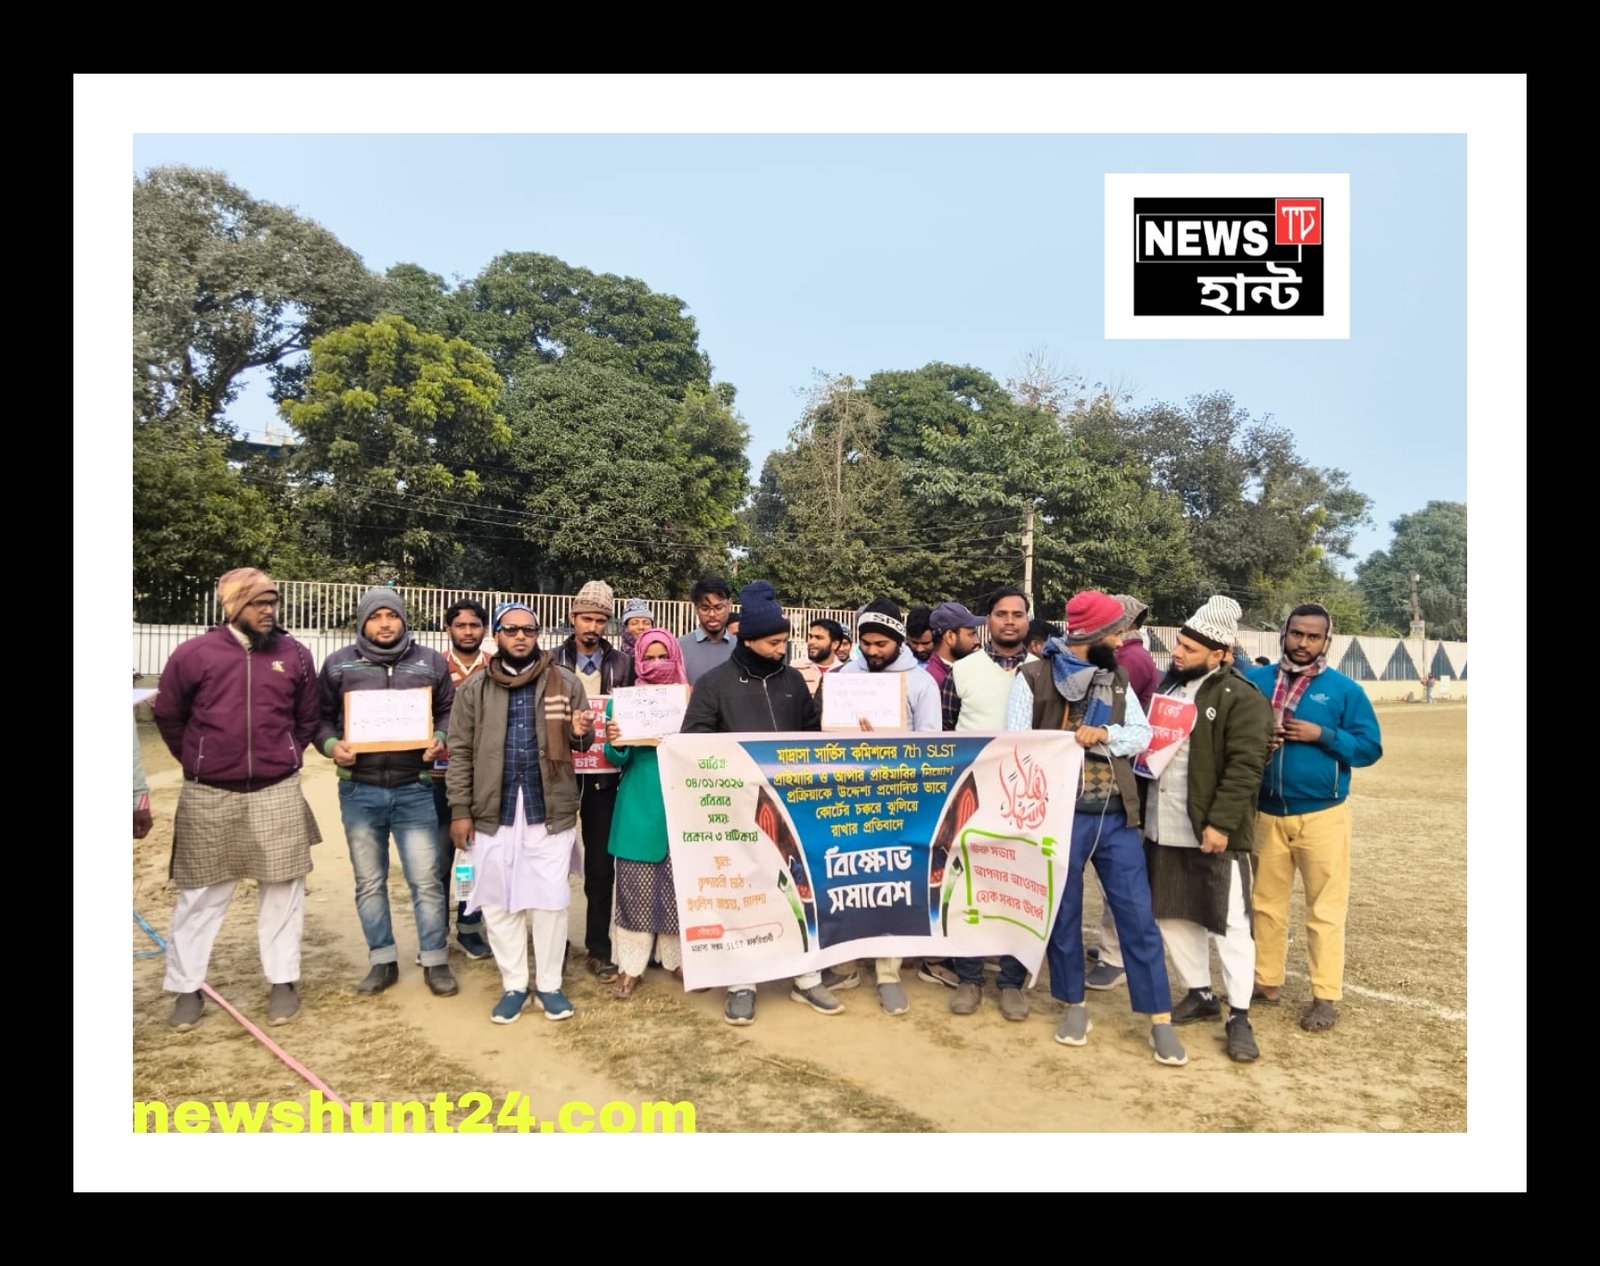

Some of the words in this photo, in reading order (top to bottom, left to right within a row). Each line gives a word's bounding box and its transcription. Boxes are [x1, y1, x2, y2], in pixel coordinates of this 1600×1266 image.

[574, 755, 599, 768] চাই
[777, 747, 810, 765] মাদ্রাসা
[814, 743, 846, 764] সার্ভিস
[851, 743, 897, 760] কমিশনের
[903, 744, 922, 758] 7th
[927, 744, 956, 757] SLST
[685, 778, 744, 788] ০৪/০১/২০২৬
[774, 771, 813, 787] প্রাইমারি
[819, 773, 828, 784] ও
[834, 769, 864, 784] আপার
[870, 764, 916, 782] প্রাইমারির
[700, 793, 731, 807] রবিবার
[787, 787, 832, 803] প্রক্রিয়াকে
[838, 785, 874, 799] উদ্দেশ্য
[877, 780, 918, 796] প্রণোদিত
[923, 781, 947, 793] ভাবে
[815, 801, 850, 819] কোর্টের
[855, 801, 882, 815] চক্করে
[887, 798, 918, 815] ঝুলিয়ে
[715, 832, 723, 841] ৩
[831, 821, 859, 838] রাখার
[863, 817, 904, 834] প্রতিবাদে
[824, 845, 912, 878] বিক্ষোভ
[973, 865, 1009, 882] আপনার
[1010, 873, 1048, 897] আওয়াজ
[827, 881, 912, 914] সমাবেশ
[976, 890, 998, 903] হোক
[999, 893, 1021, 909] সবার
